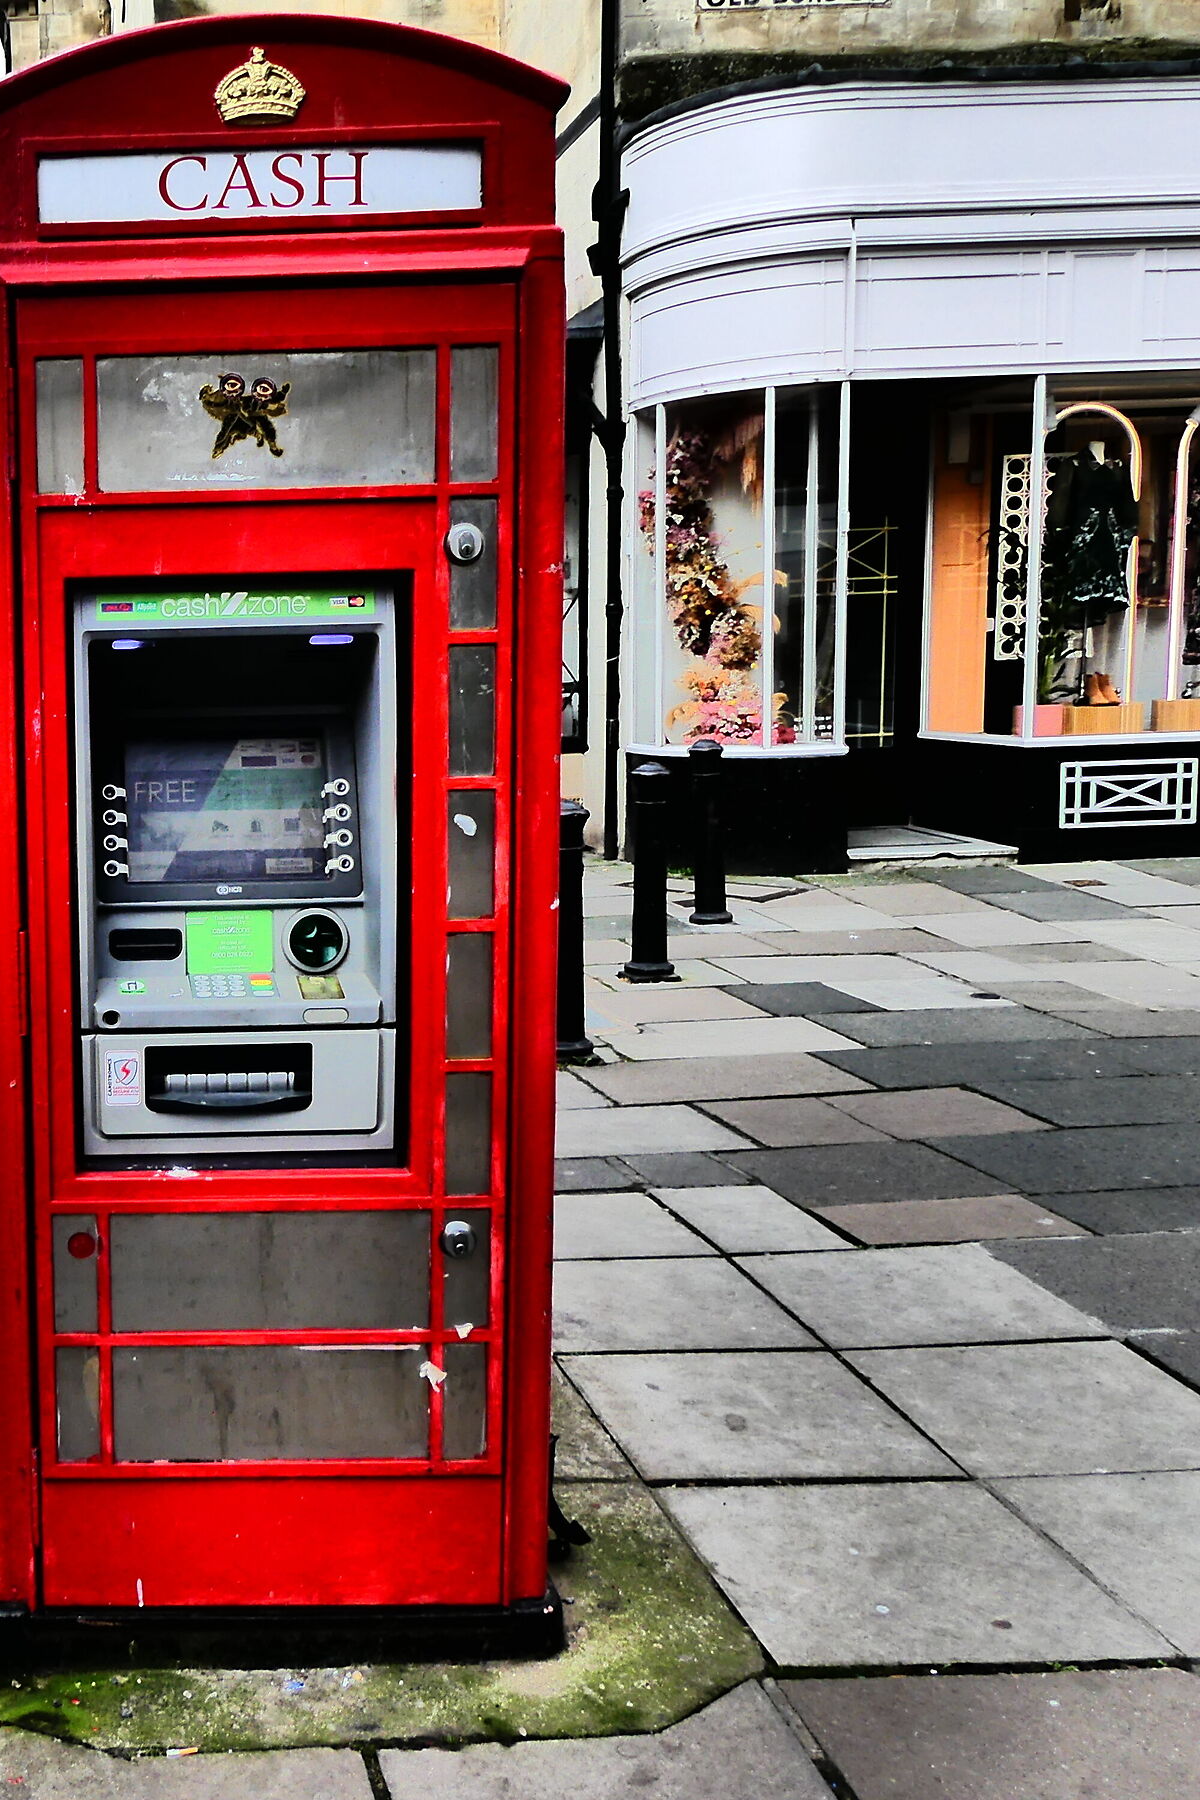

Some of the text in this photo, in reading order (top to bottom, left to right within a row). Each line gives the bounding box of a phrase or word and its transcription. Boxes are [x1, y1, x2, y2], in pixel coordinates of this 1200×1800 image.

[158, 152, 369, 210] CASH
[161, 592, 307, 617] cash zone
[134, 780, 196, 803] FREE
